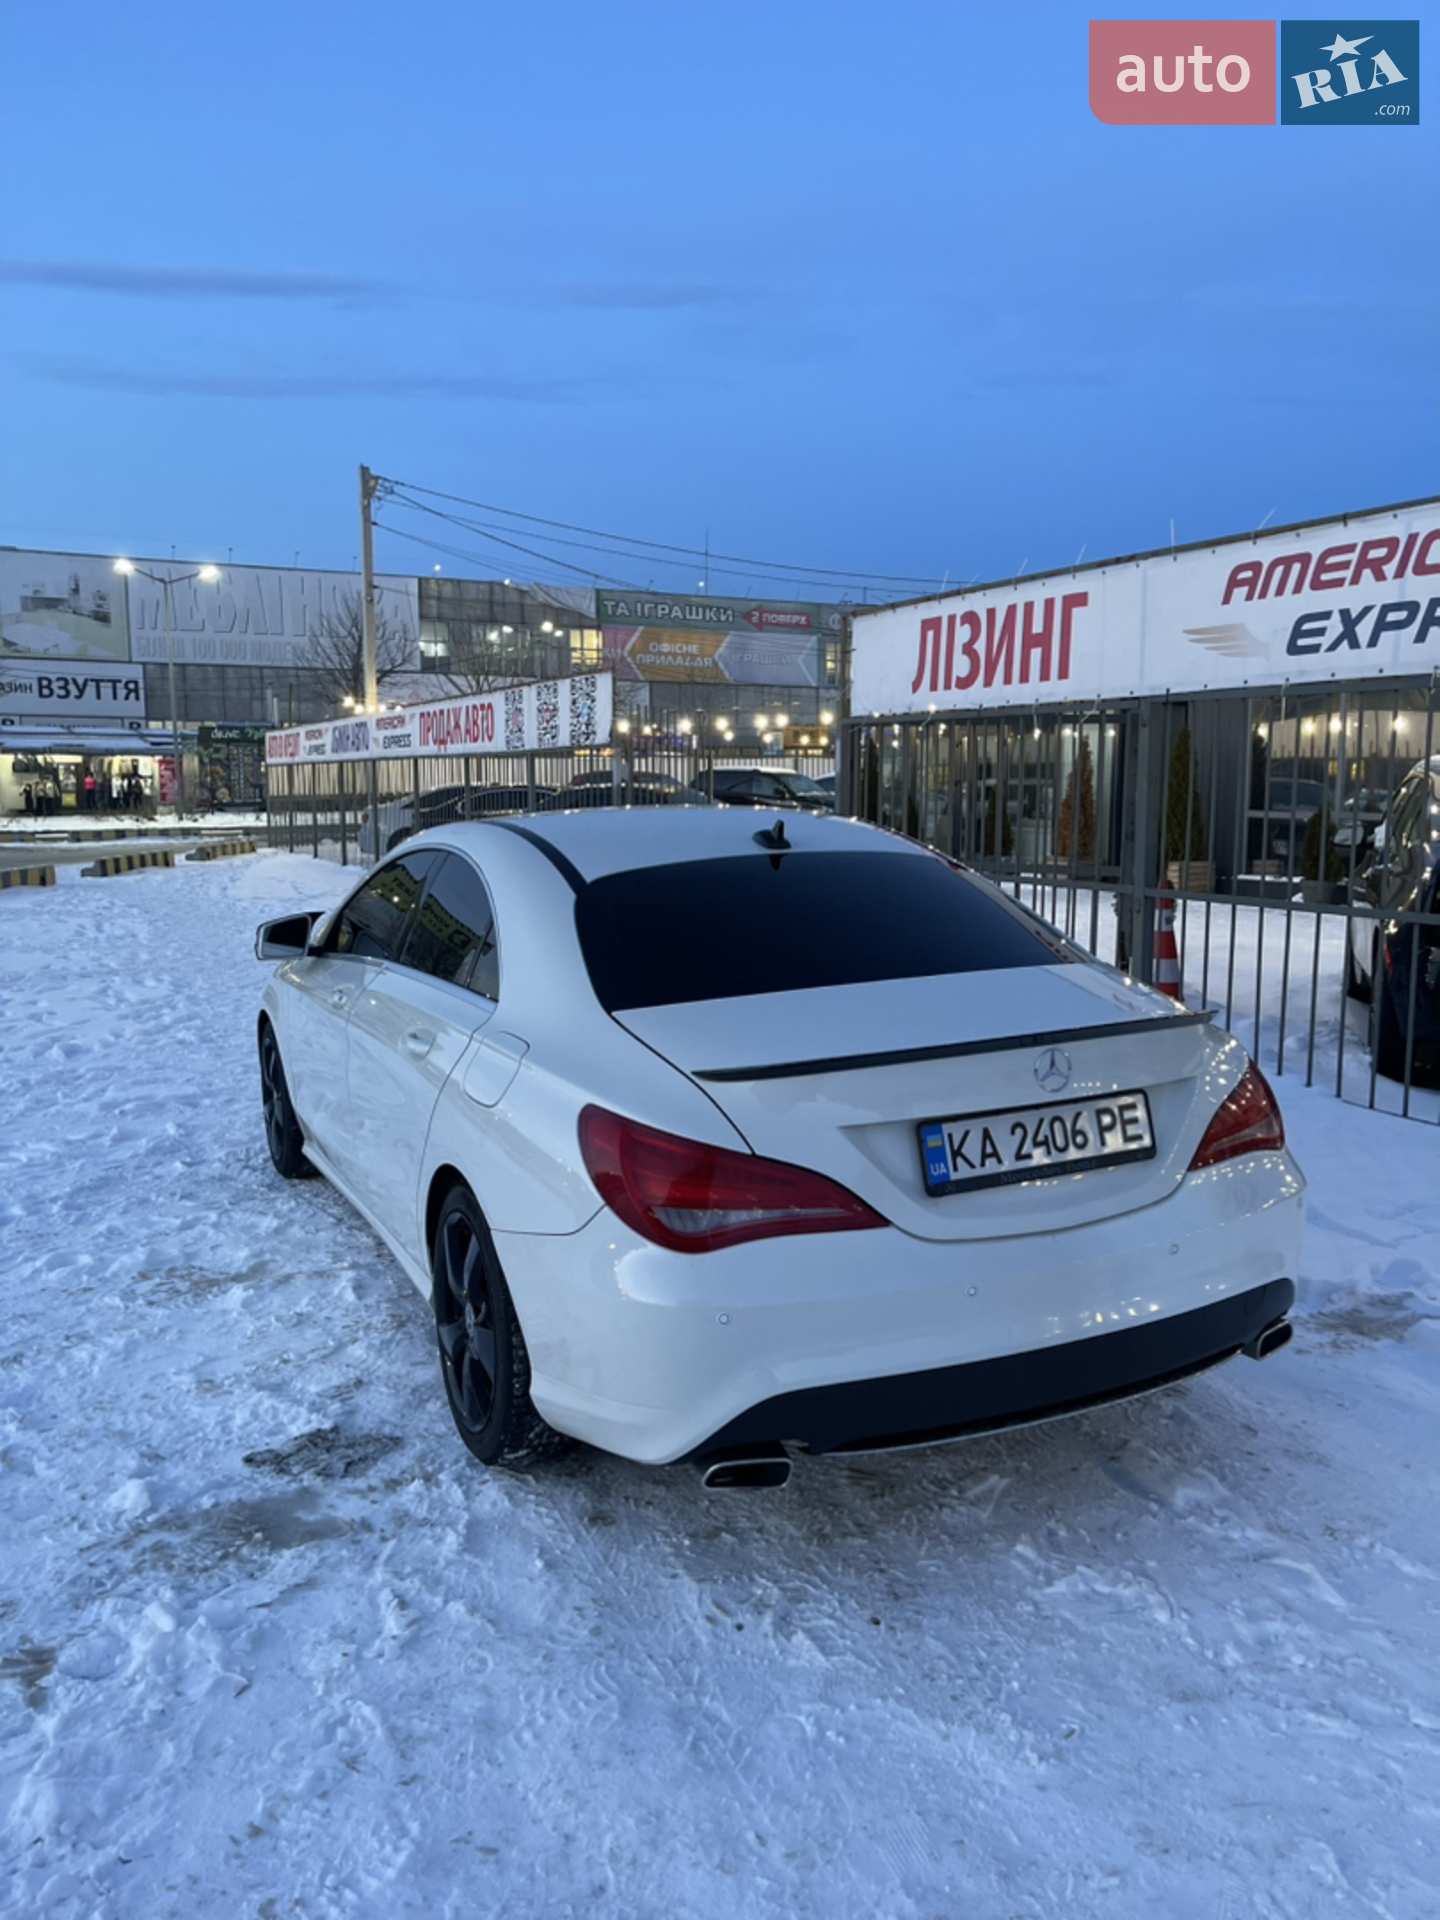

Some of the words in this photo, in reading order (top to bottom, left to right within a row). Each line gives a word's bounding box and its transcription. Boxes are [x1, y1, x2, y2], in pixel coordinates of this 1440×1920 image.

[603, 600, 631, 617] ТА
[636, 603, 735, 623] ІГРАШКИ
[649, 641, 701, 656] ОФІСНЕ
[911, 591, 1089, 696] ЛІЗИНГ
[37, 676, 140, 702] ВЗУТТЯ
[418, 705, 463, 753] ПРОДАЖ
[463, 702, 495, 744] АВТО
[1010, 1111, 1089, 1162] 2406
[930, 1161, 948, 1176] UA
